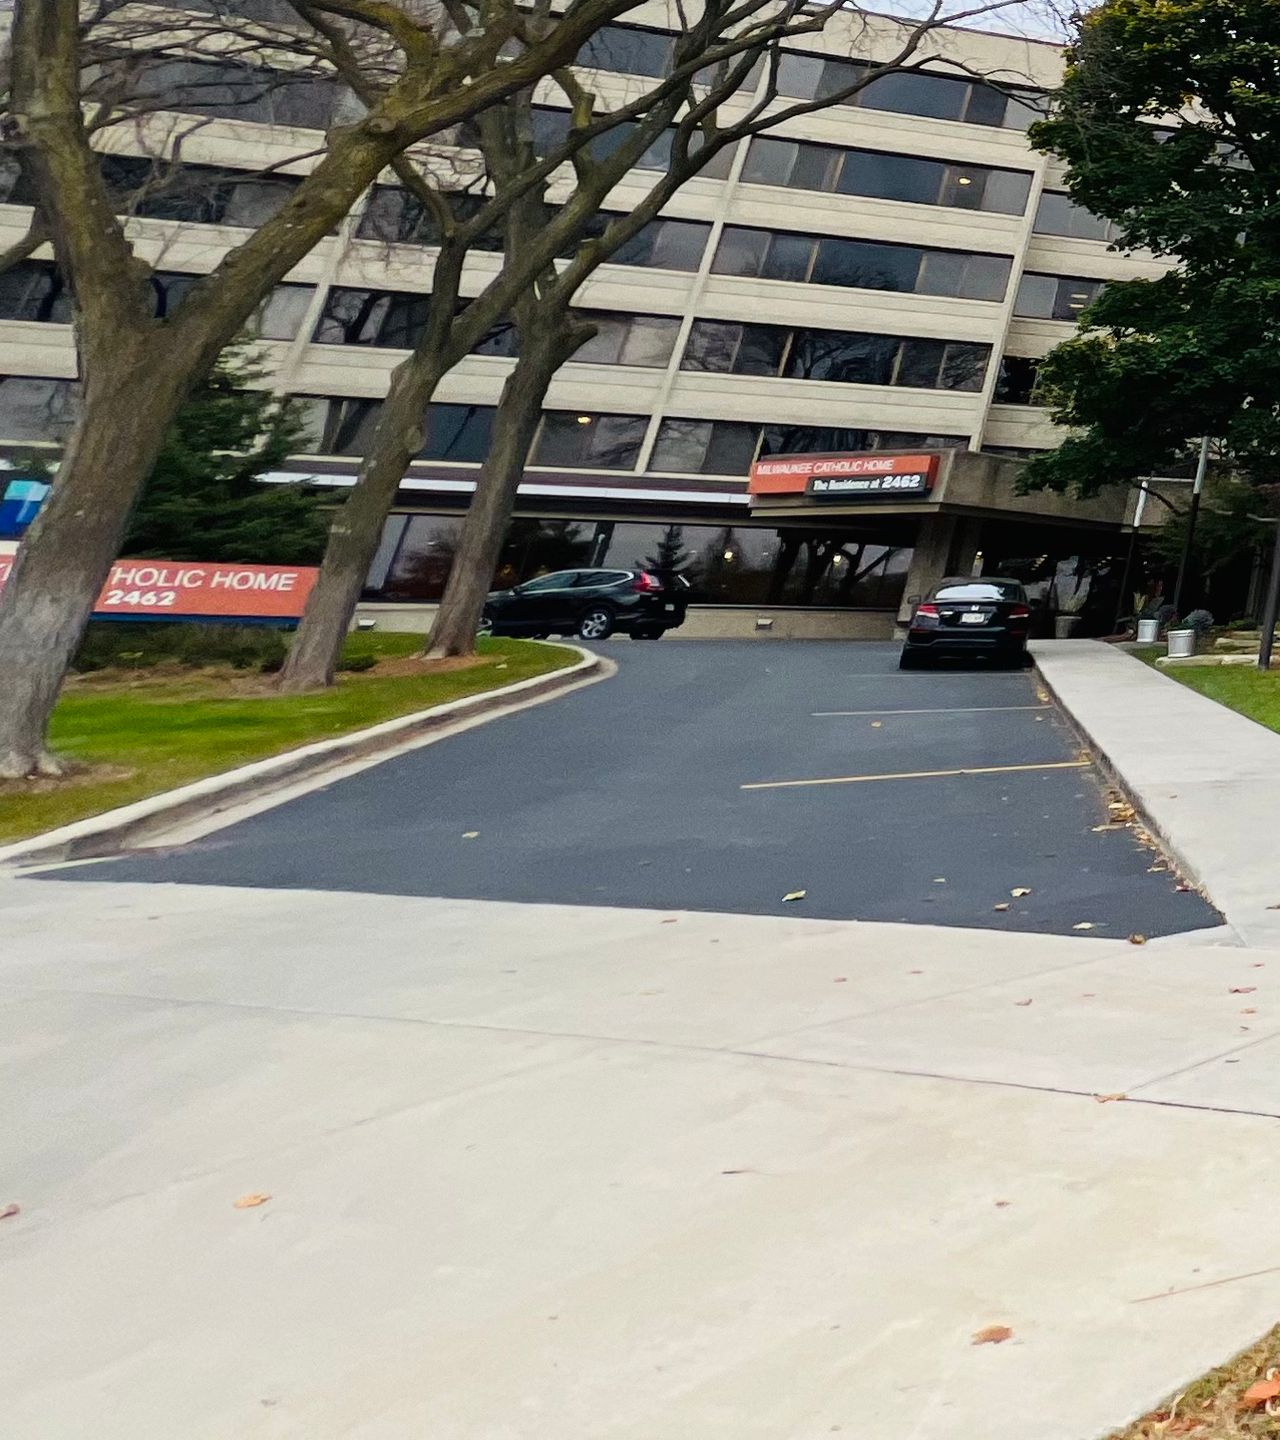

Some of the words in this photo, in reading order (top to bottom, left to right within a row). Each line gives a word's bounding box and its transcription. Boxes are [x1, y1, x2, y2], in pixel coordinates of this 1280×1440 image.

[757, 463, 813, 475] MILWAUKEE
[813, 461, 862, 474] CATHOLIC
[863, 460, 896, 471] HOME
[813, 479, 828, 491] The
[869, 478, 881, 489] at
[881, 475, 921, 488] 2462
[112, 567, 205, 588] HOLIC
[210, 571, 298, 591] HOME
[104, 590, 176, 606] 2462
